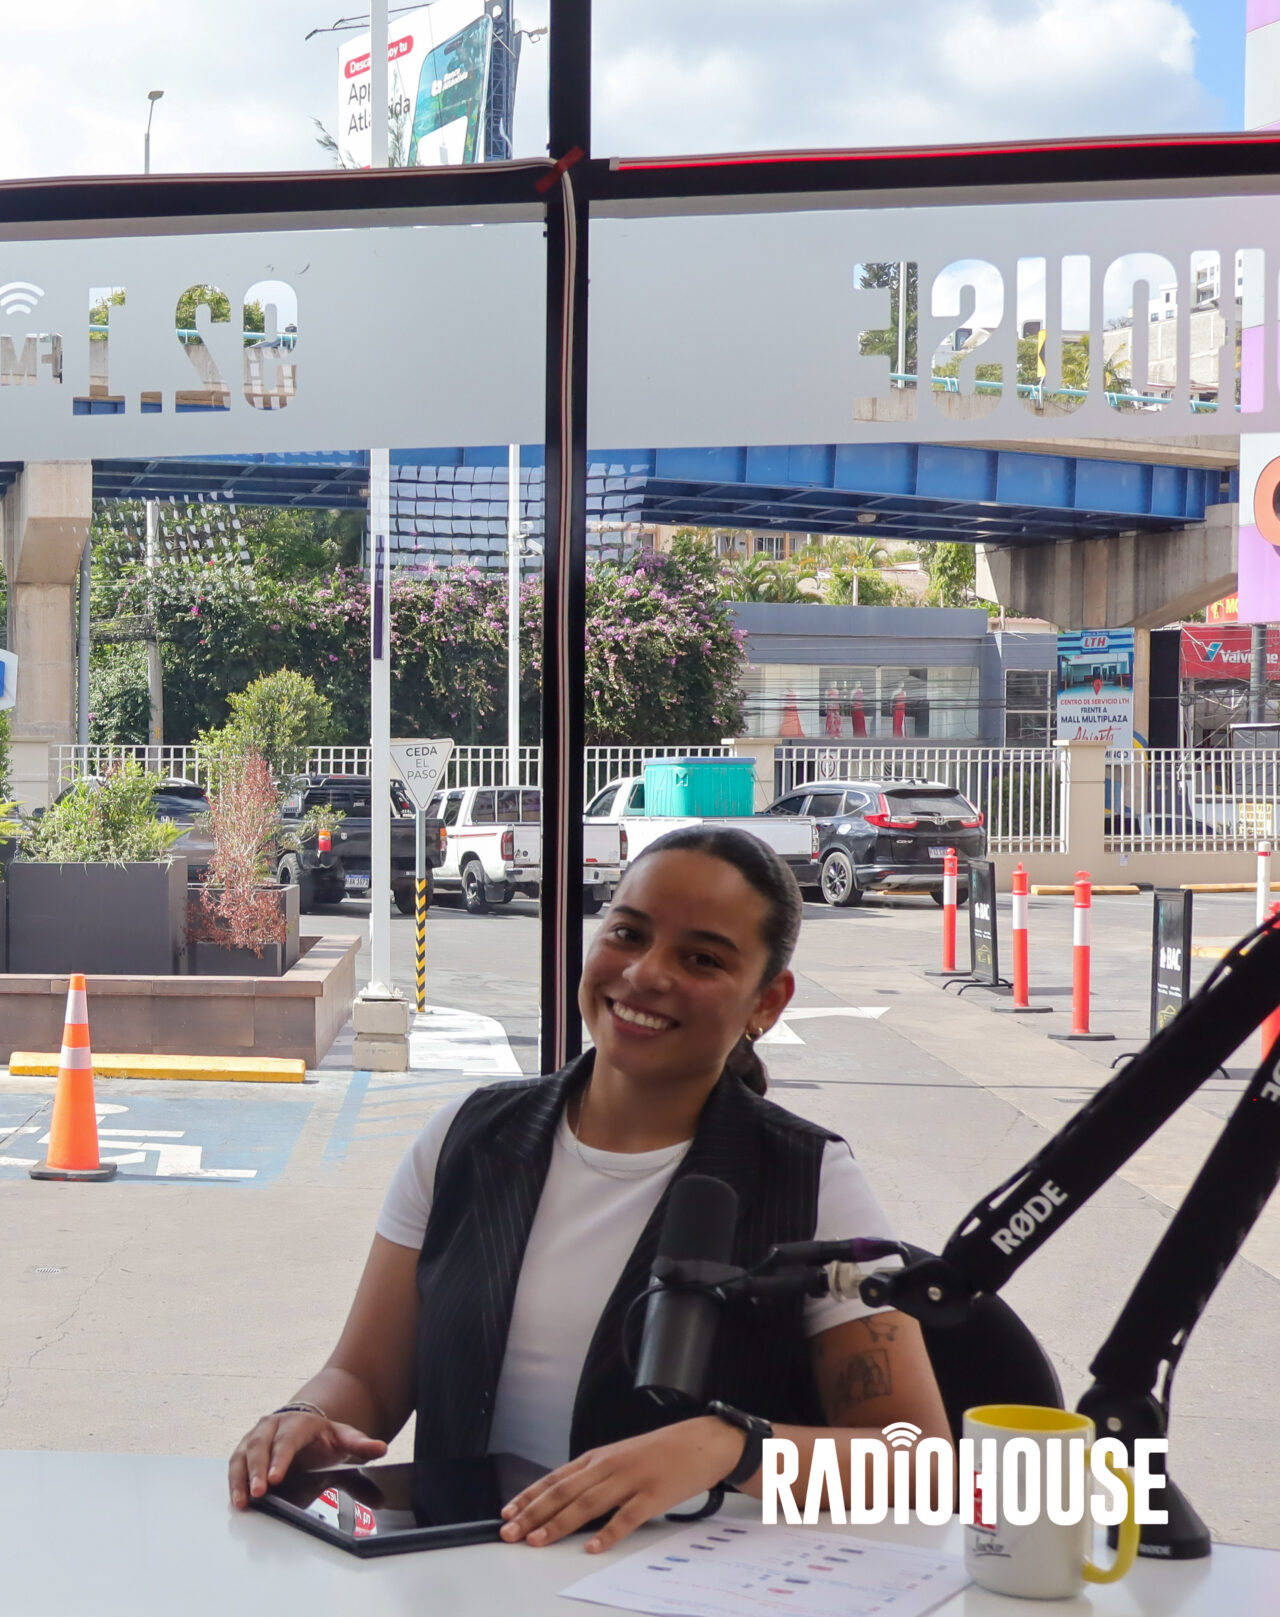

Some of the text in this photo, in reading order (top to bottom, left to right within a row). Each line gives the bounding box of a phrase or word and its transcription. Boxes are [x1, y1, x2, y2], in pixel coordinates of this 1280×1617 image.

[1084, 636, 1106, 648] LTH
[1061, 714, 1128, 723] MALL MULTIPLAZA
[406, 746, 438, 757] CEDA
[415, 758, 429, 768] EL
[407, 769, 437, 781] PASO
[1166, 947, 1182, 972] BAC
